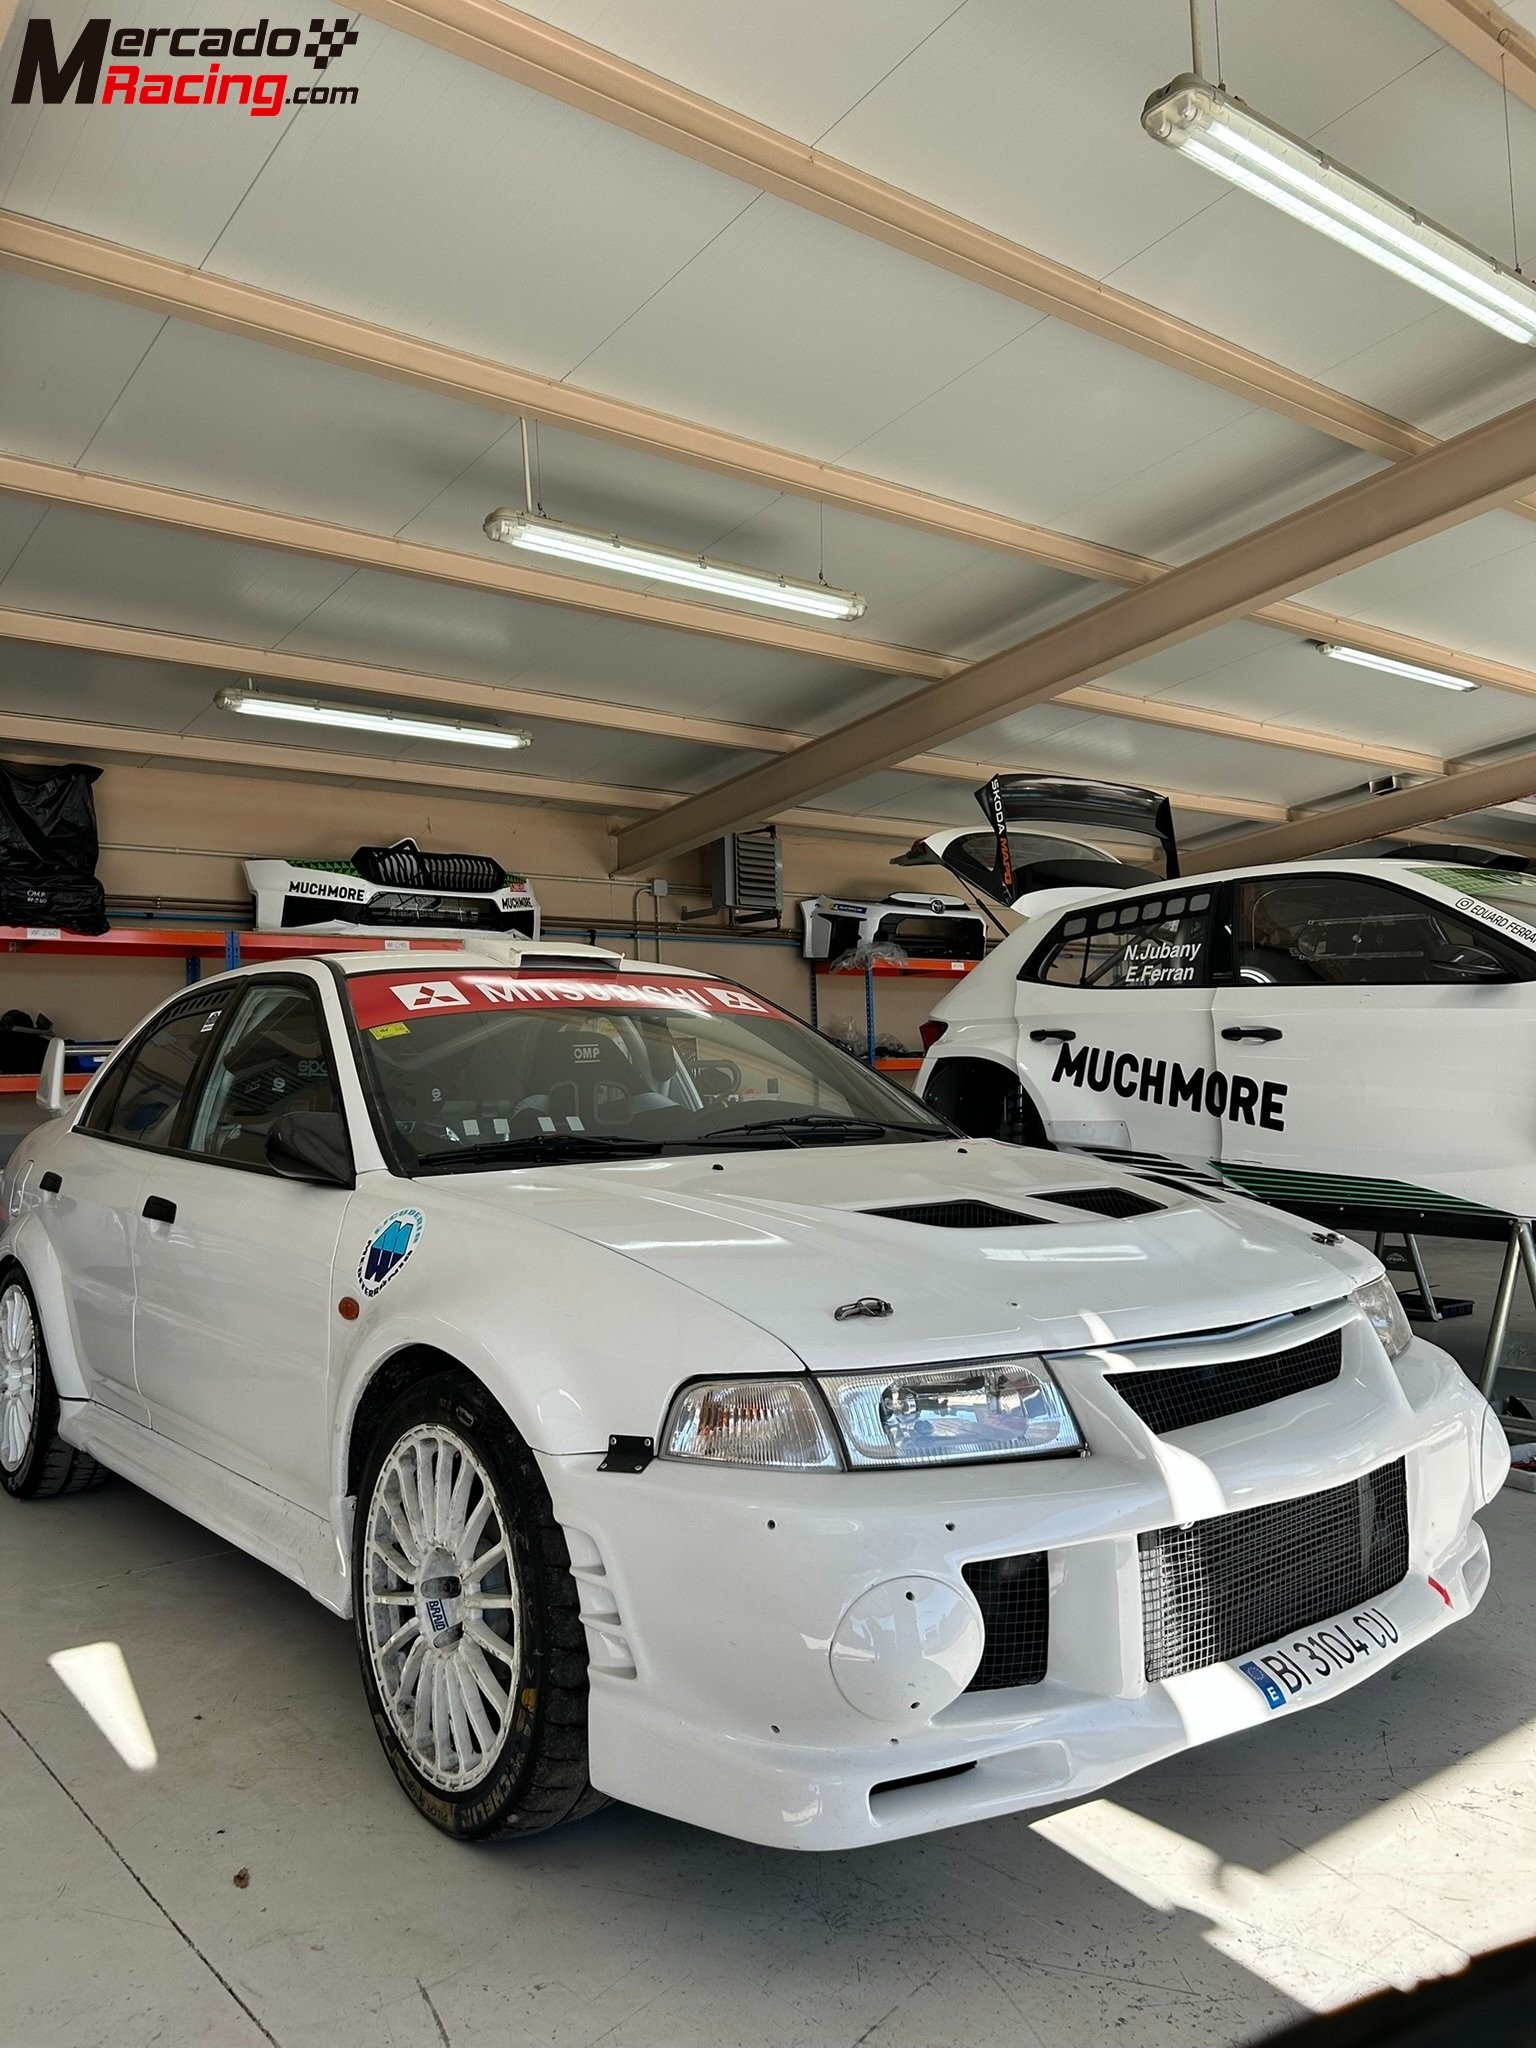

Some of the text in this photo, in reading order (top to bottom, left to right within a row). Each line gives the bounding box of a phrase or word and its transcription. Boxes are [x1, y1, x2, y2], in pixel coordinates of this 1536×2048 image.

[991, 779, 1005, 835] SKODA
[289, 880, 365, 902] MUCHMORE
[1470, 904, 1536, 945] EDUARD FERRA
[1124, 942, 1202, 962] N.Jubany
[1125, 965, 1195, 983] E.Ferran
[475, 982, 712, 1006] MITSUBISHI
[573, 1047, 600, 1060] OMP
[1051, 1042, 1288, 1132] MUCHMORE
[428, 1600, 446, 1631] BRAID
[1260, 1607, 1399, 1695] BI 3104 CU
[1266, 1686, 1280, 1702] E
